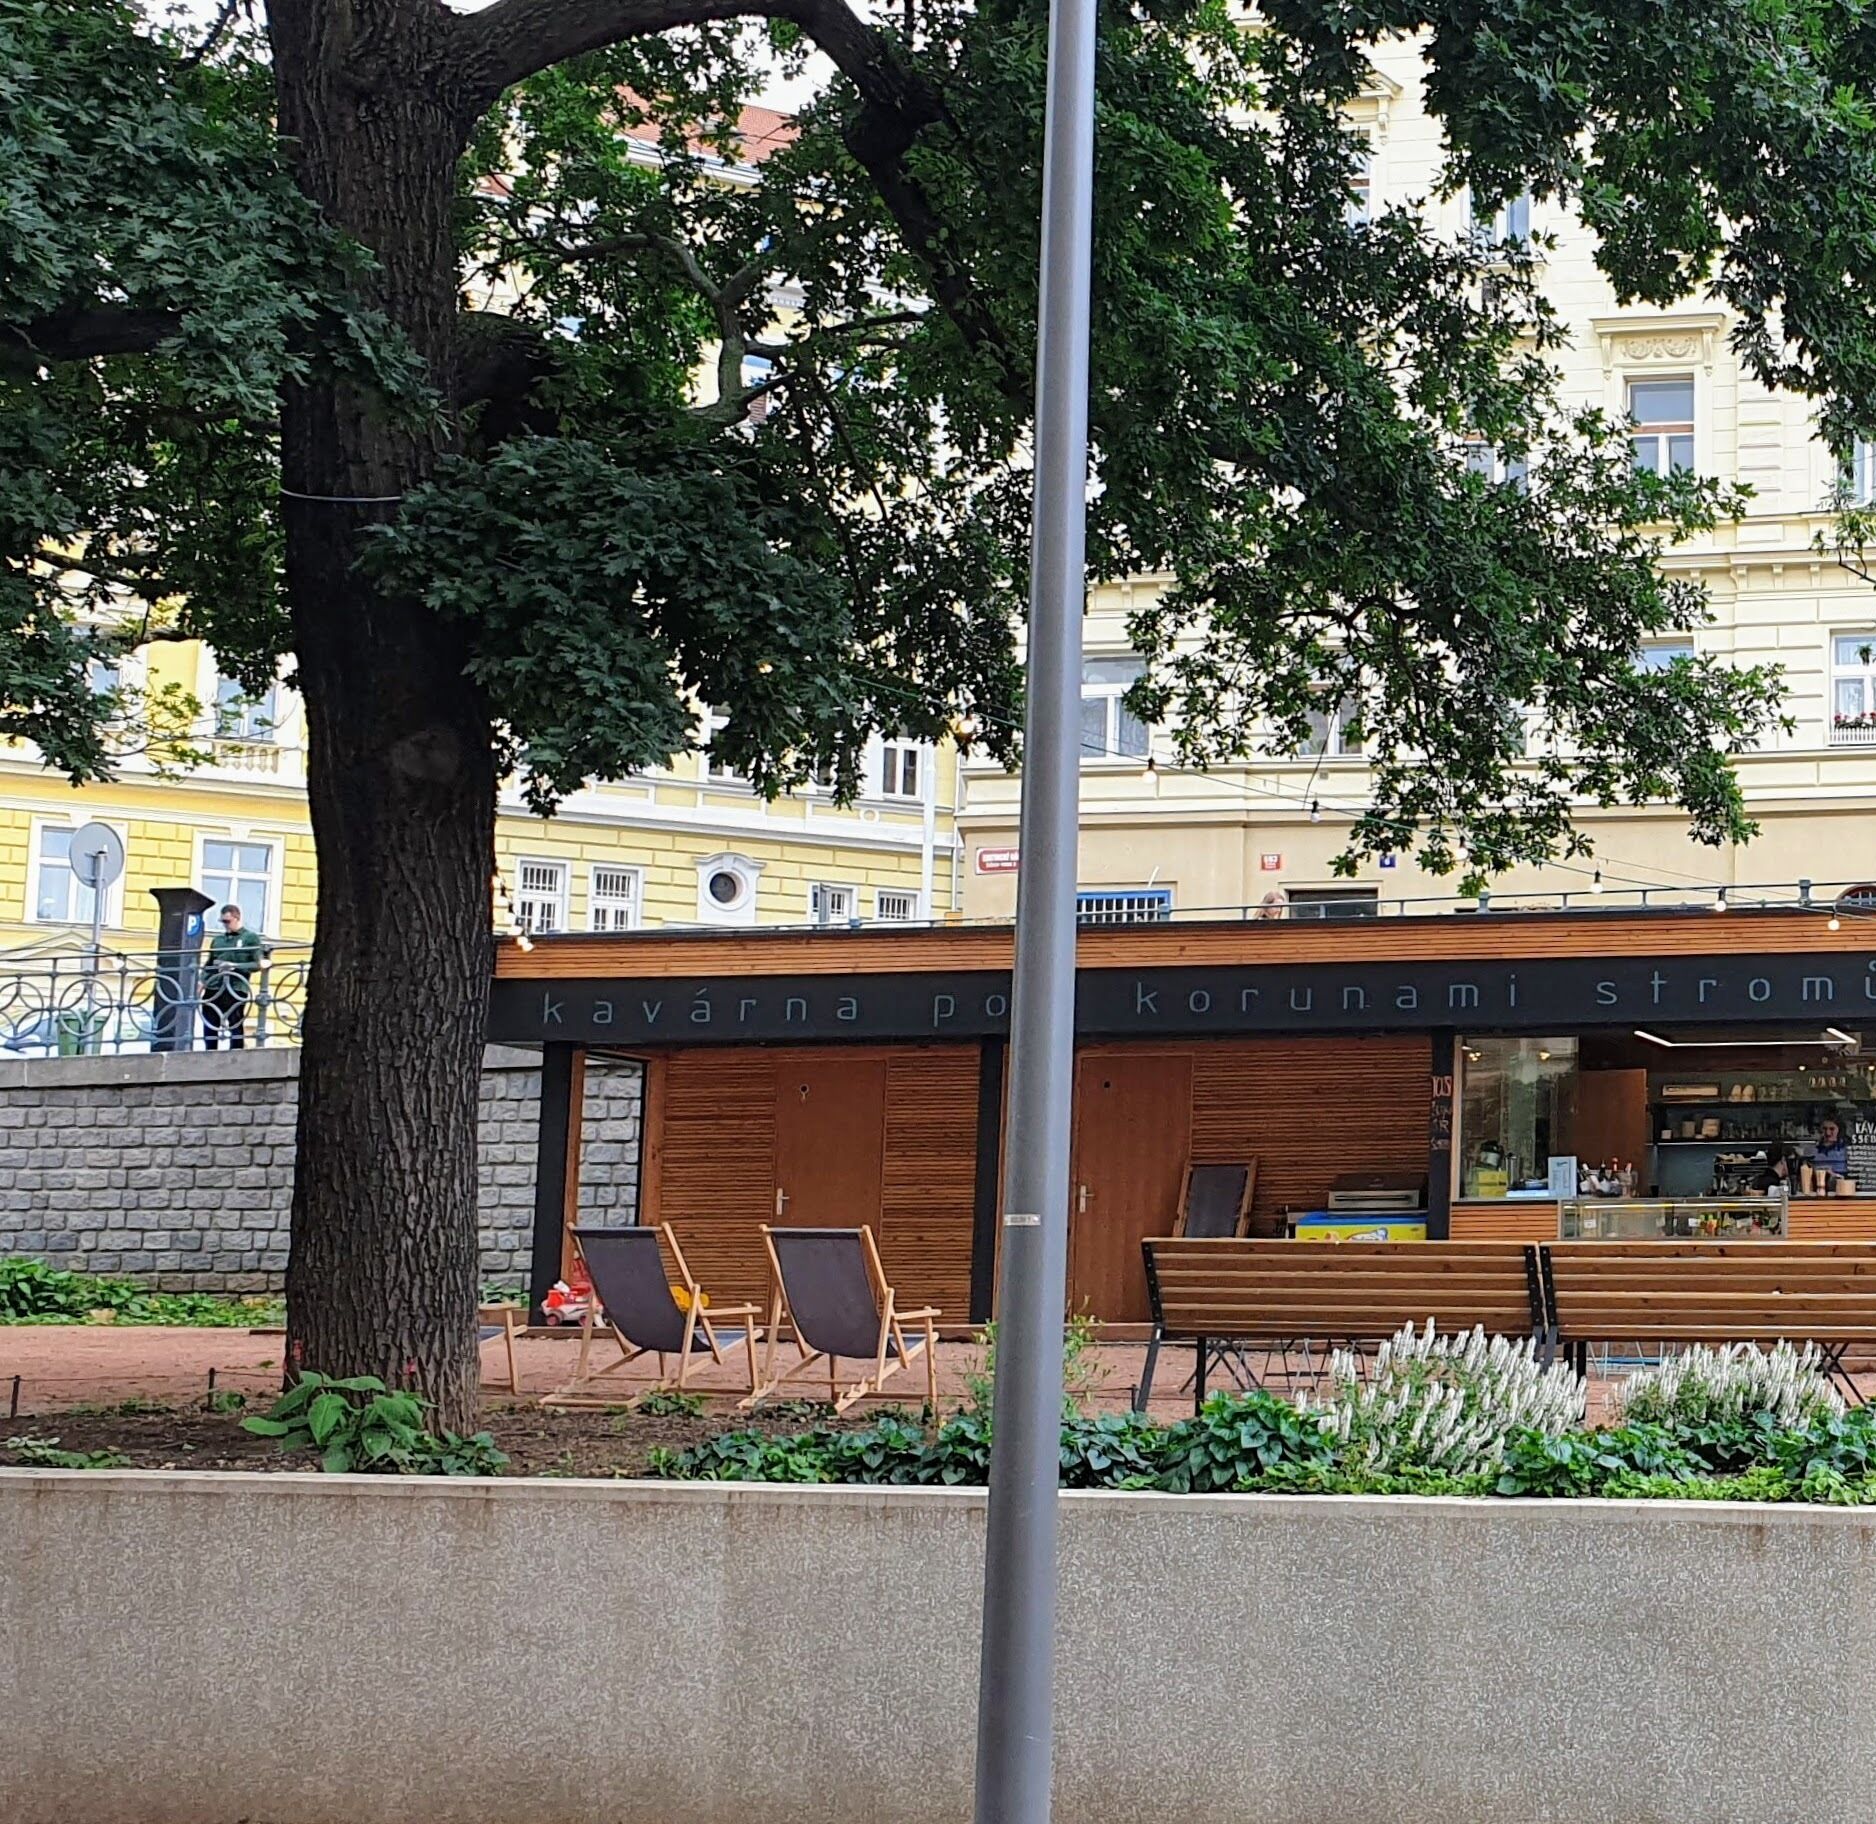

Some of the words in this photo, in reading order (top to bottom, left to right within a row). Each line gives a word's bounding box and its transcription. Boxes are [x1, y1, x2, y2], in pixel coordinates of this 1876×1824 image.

[543, 987, 858, 1024] kavárna
[932, 994, 1007, 1028] po
[1135, 973, 1516, 1015] korunami
